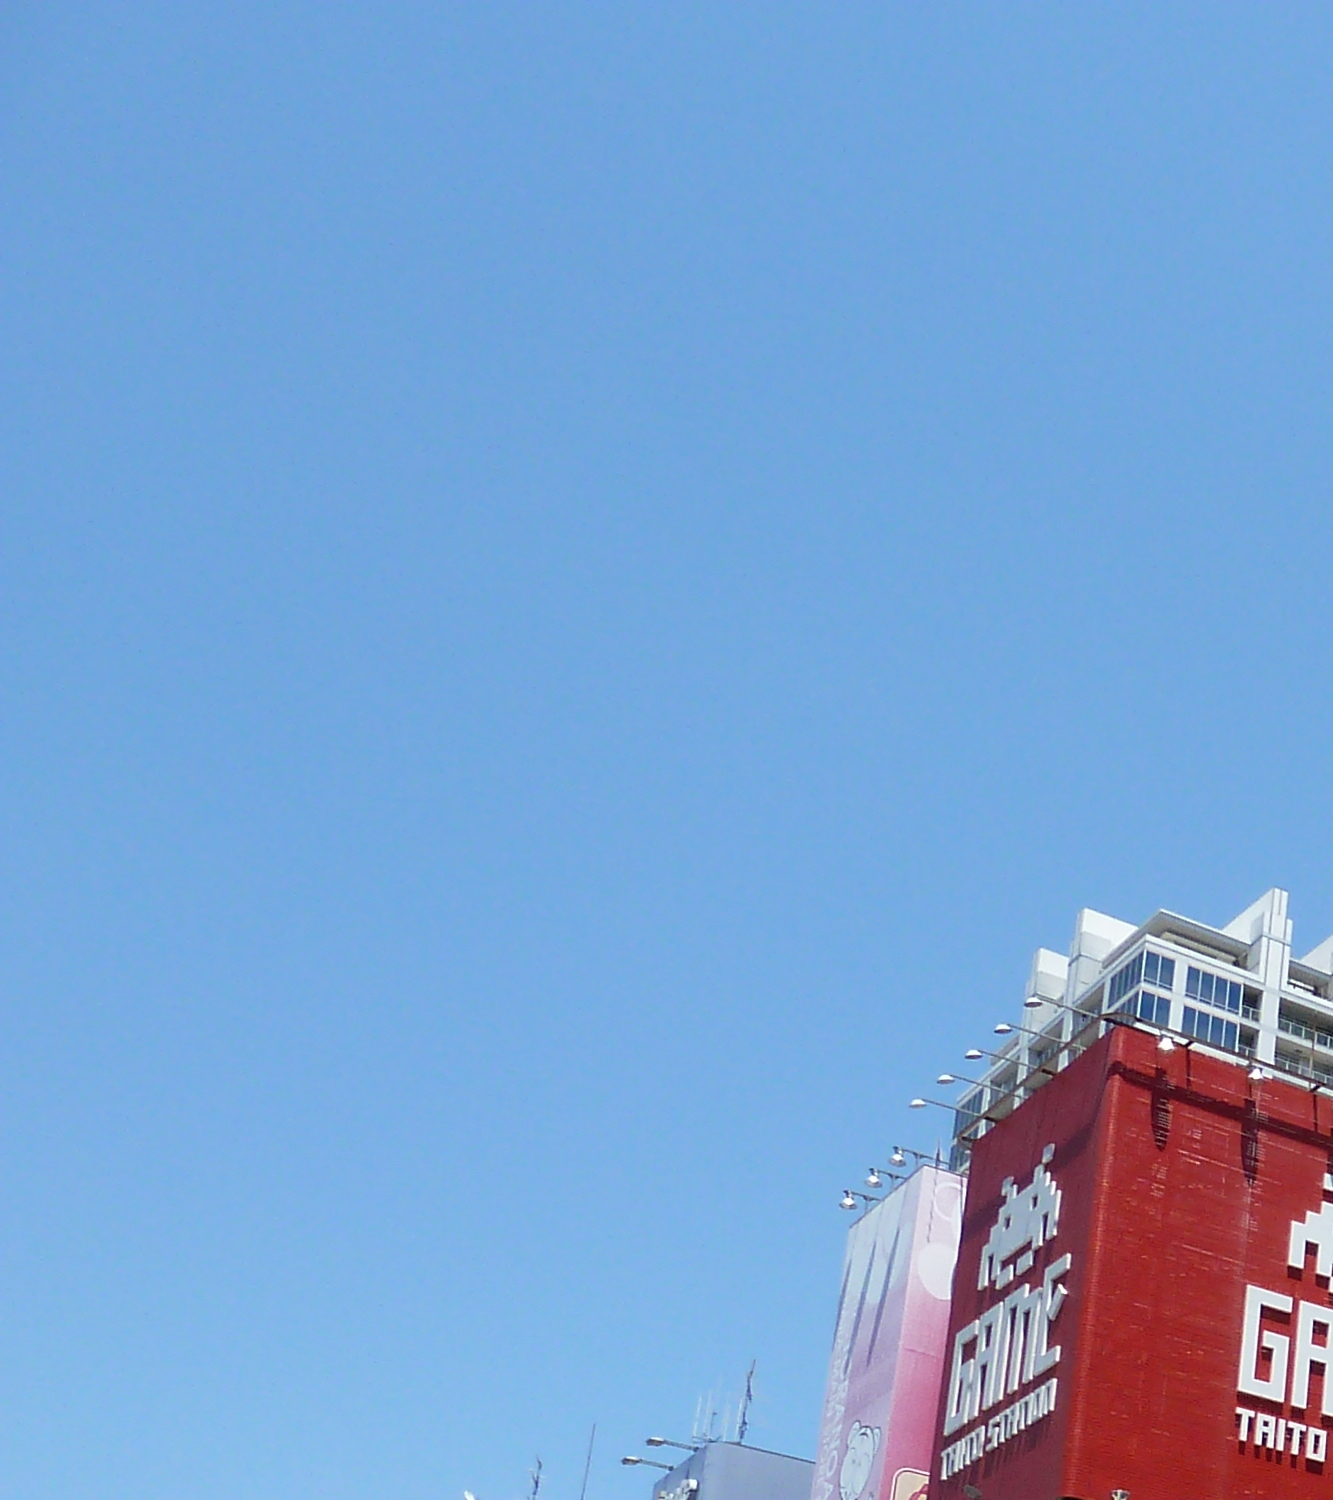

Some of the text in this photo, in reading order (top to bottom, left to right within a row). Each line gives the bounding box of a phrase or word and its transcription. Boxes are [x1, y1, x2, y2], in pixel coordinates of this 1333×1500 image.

[943, 1252, 1072, 1437] GAME
[939, 1377, 1058, 1481] TAITO STATION
[1235, 1406, 1326, 1463] TAITO
